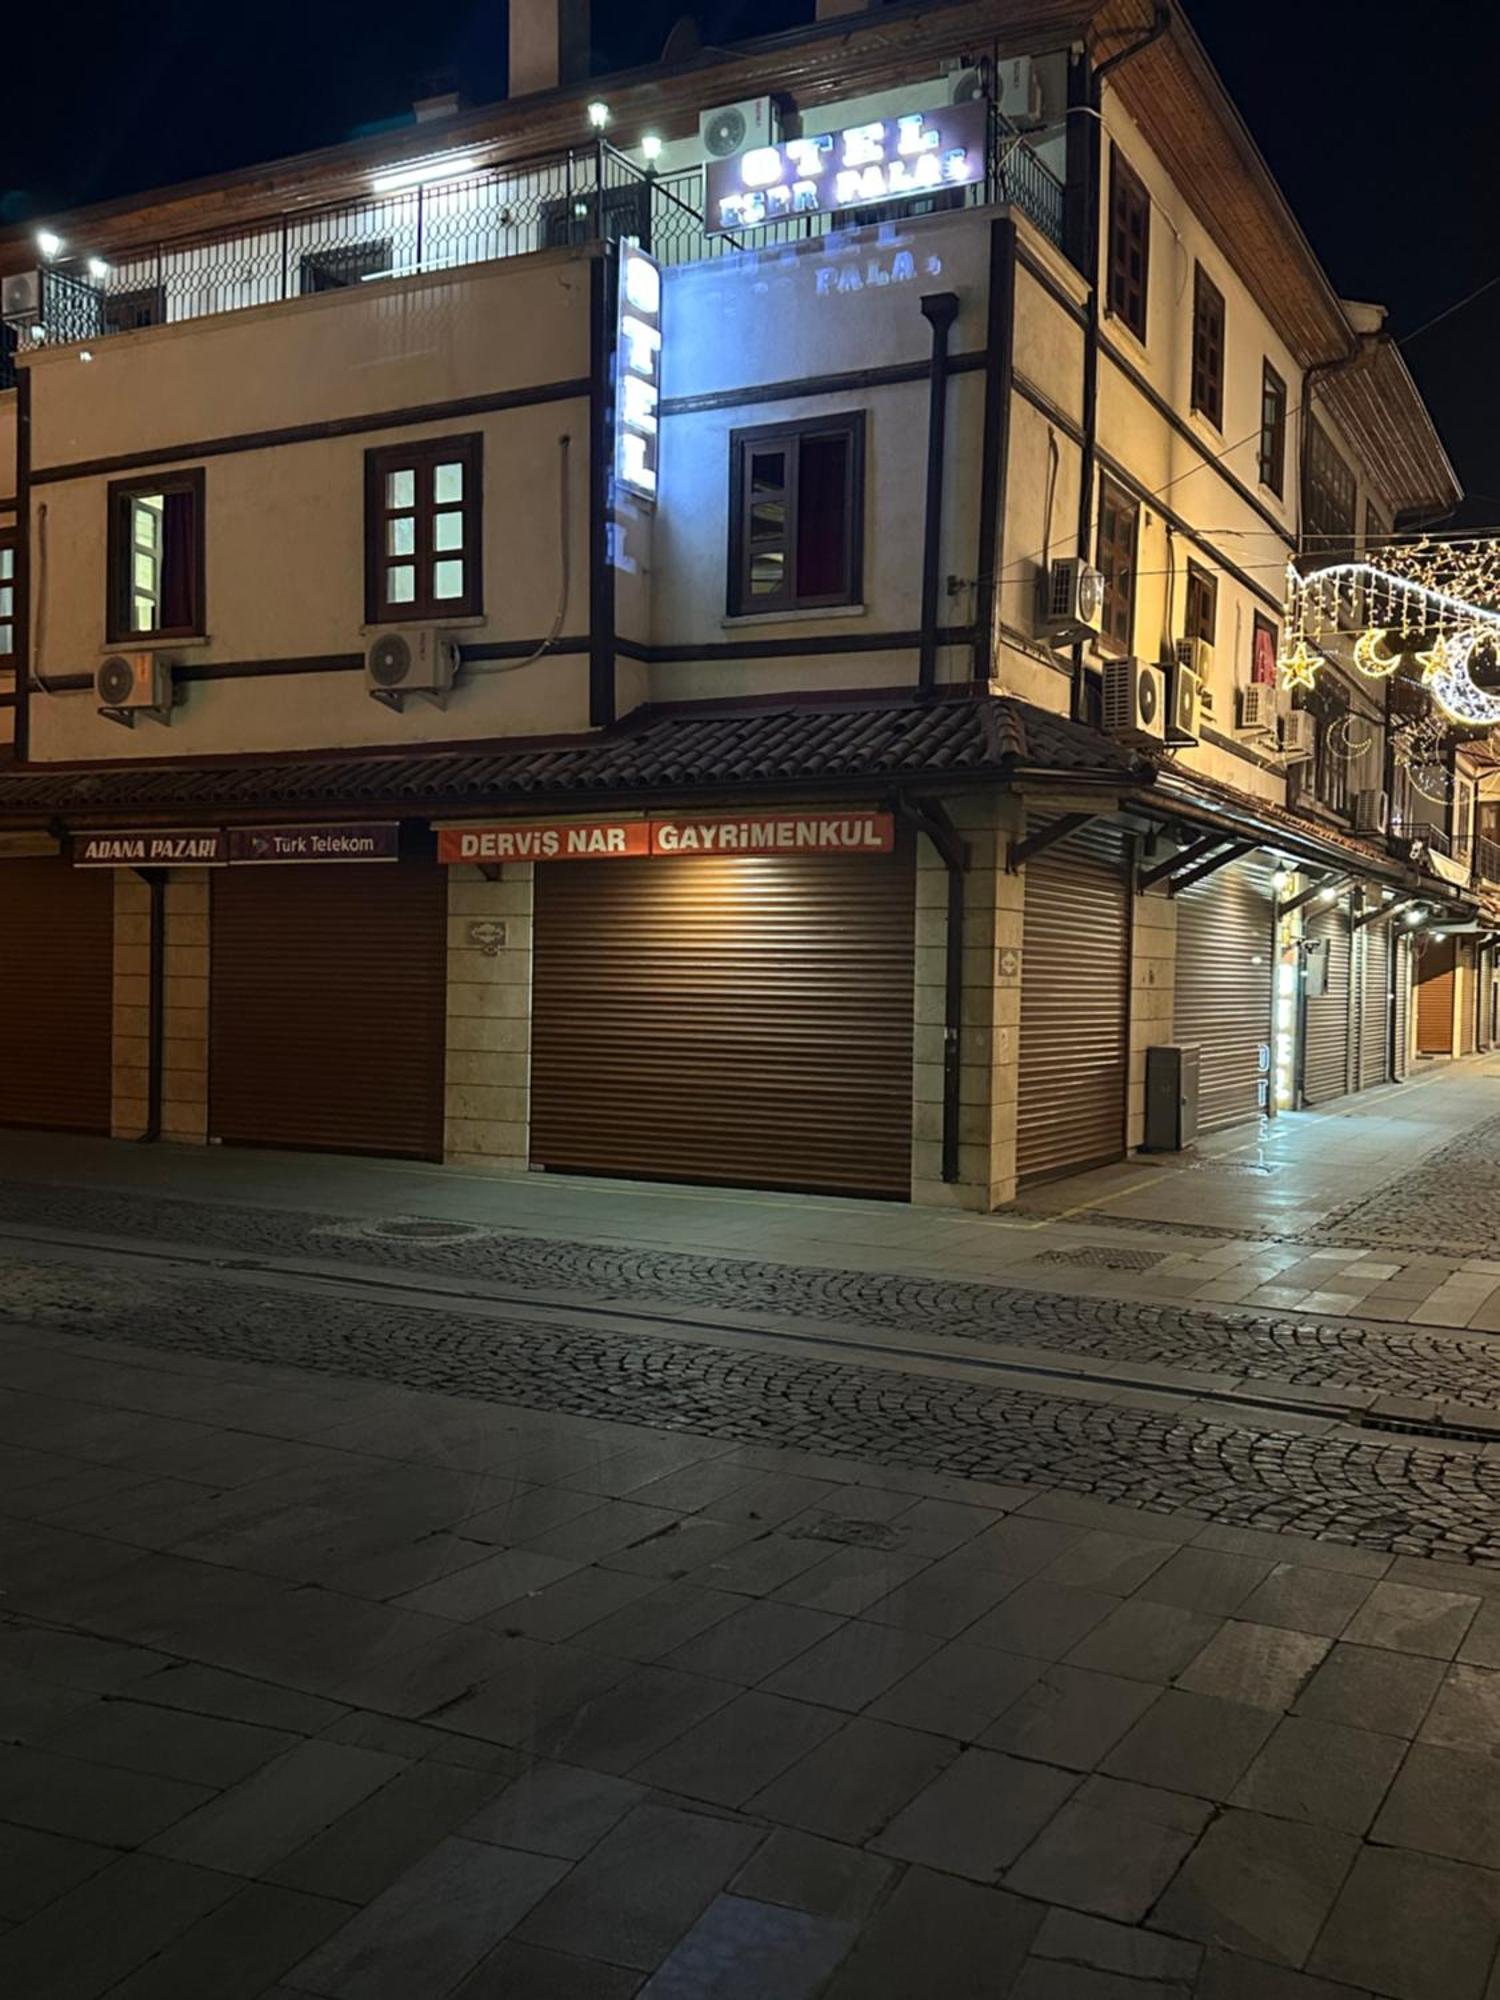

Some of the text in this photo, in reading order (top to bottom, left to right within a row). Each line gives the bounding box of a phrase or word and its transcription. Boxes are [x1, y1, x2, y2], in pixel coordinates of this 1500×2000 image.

[741, 113, 941, 187] OTEL
[622, 257, 661, 490] OTEL
[85, 839, 217, 858] ADANA PAZARI
[274, 835, 374, 853] Türk Telekom
[567, 828, 626, 853] NAR
